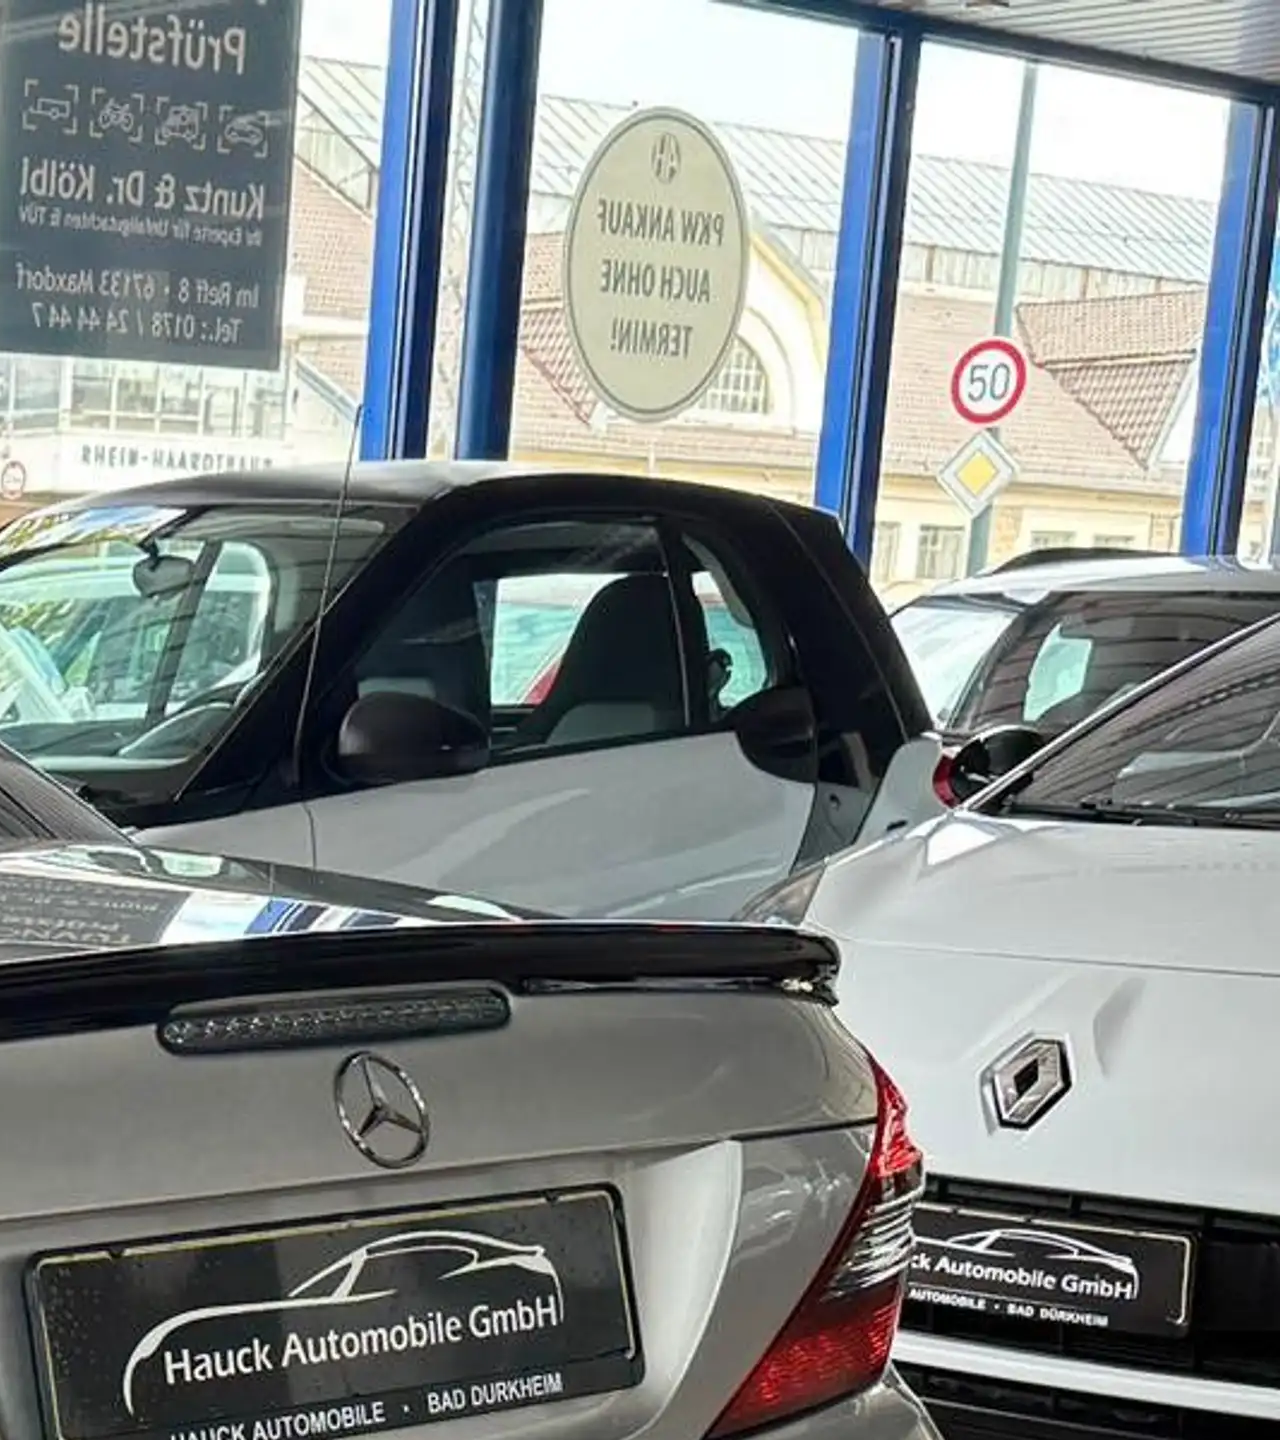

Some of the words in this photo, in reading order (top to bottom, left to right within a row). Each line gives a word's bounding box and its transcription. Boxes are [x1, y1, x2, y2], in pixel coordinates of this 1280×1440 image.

[966, 363, 1012, 402] 50
[934, 1254, 1057, 1291] Automobile
[1060, 1273, 1133, 1300] GmbH
[908, 1287, 987, 1311] AUTOMOBILE
[1006, 1302, 1035, 1318] BAD
[163, 1337, 273, 1385] Hauck
[280, 1309, 462, 1369] Automobile
[468, 1294, 558, 1339] GmbH
[426, 1387, 467, 1415] BAD
